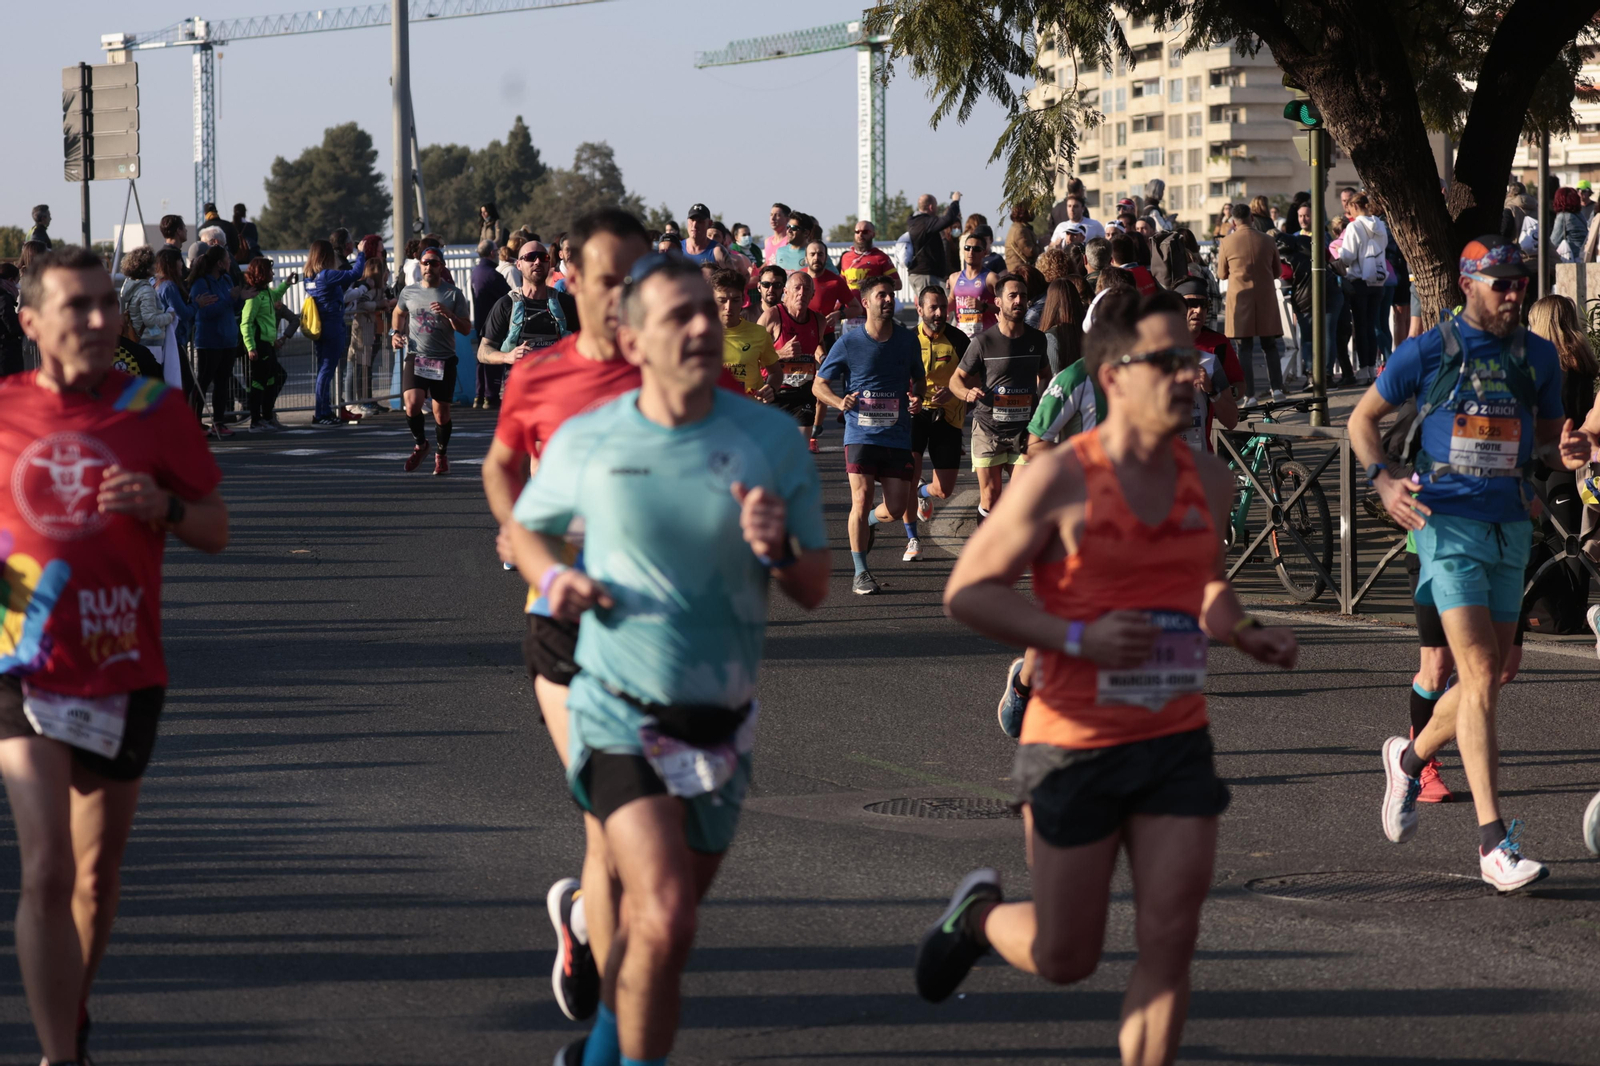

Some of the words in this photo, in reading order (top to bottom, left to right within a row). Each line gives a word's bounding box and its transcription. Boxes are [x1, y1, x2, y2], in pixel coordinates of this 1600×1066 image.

[860, 65, 869, 148] urbantech
[860, 154, 869, 204] titania
[1480, 404, 1515, 416] ZURICH
[1478, 425, 1502, 437] 5225
[1475, 442, 1503, 452] POOTIE
[78, 585, 143, 616] RUN
